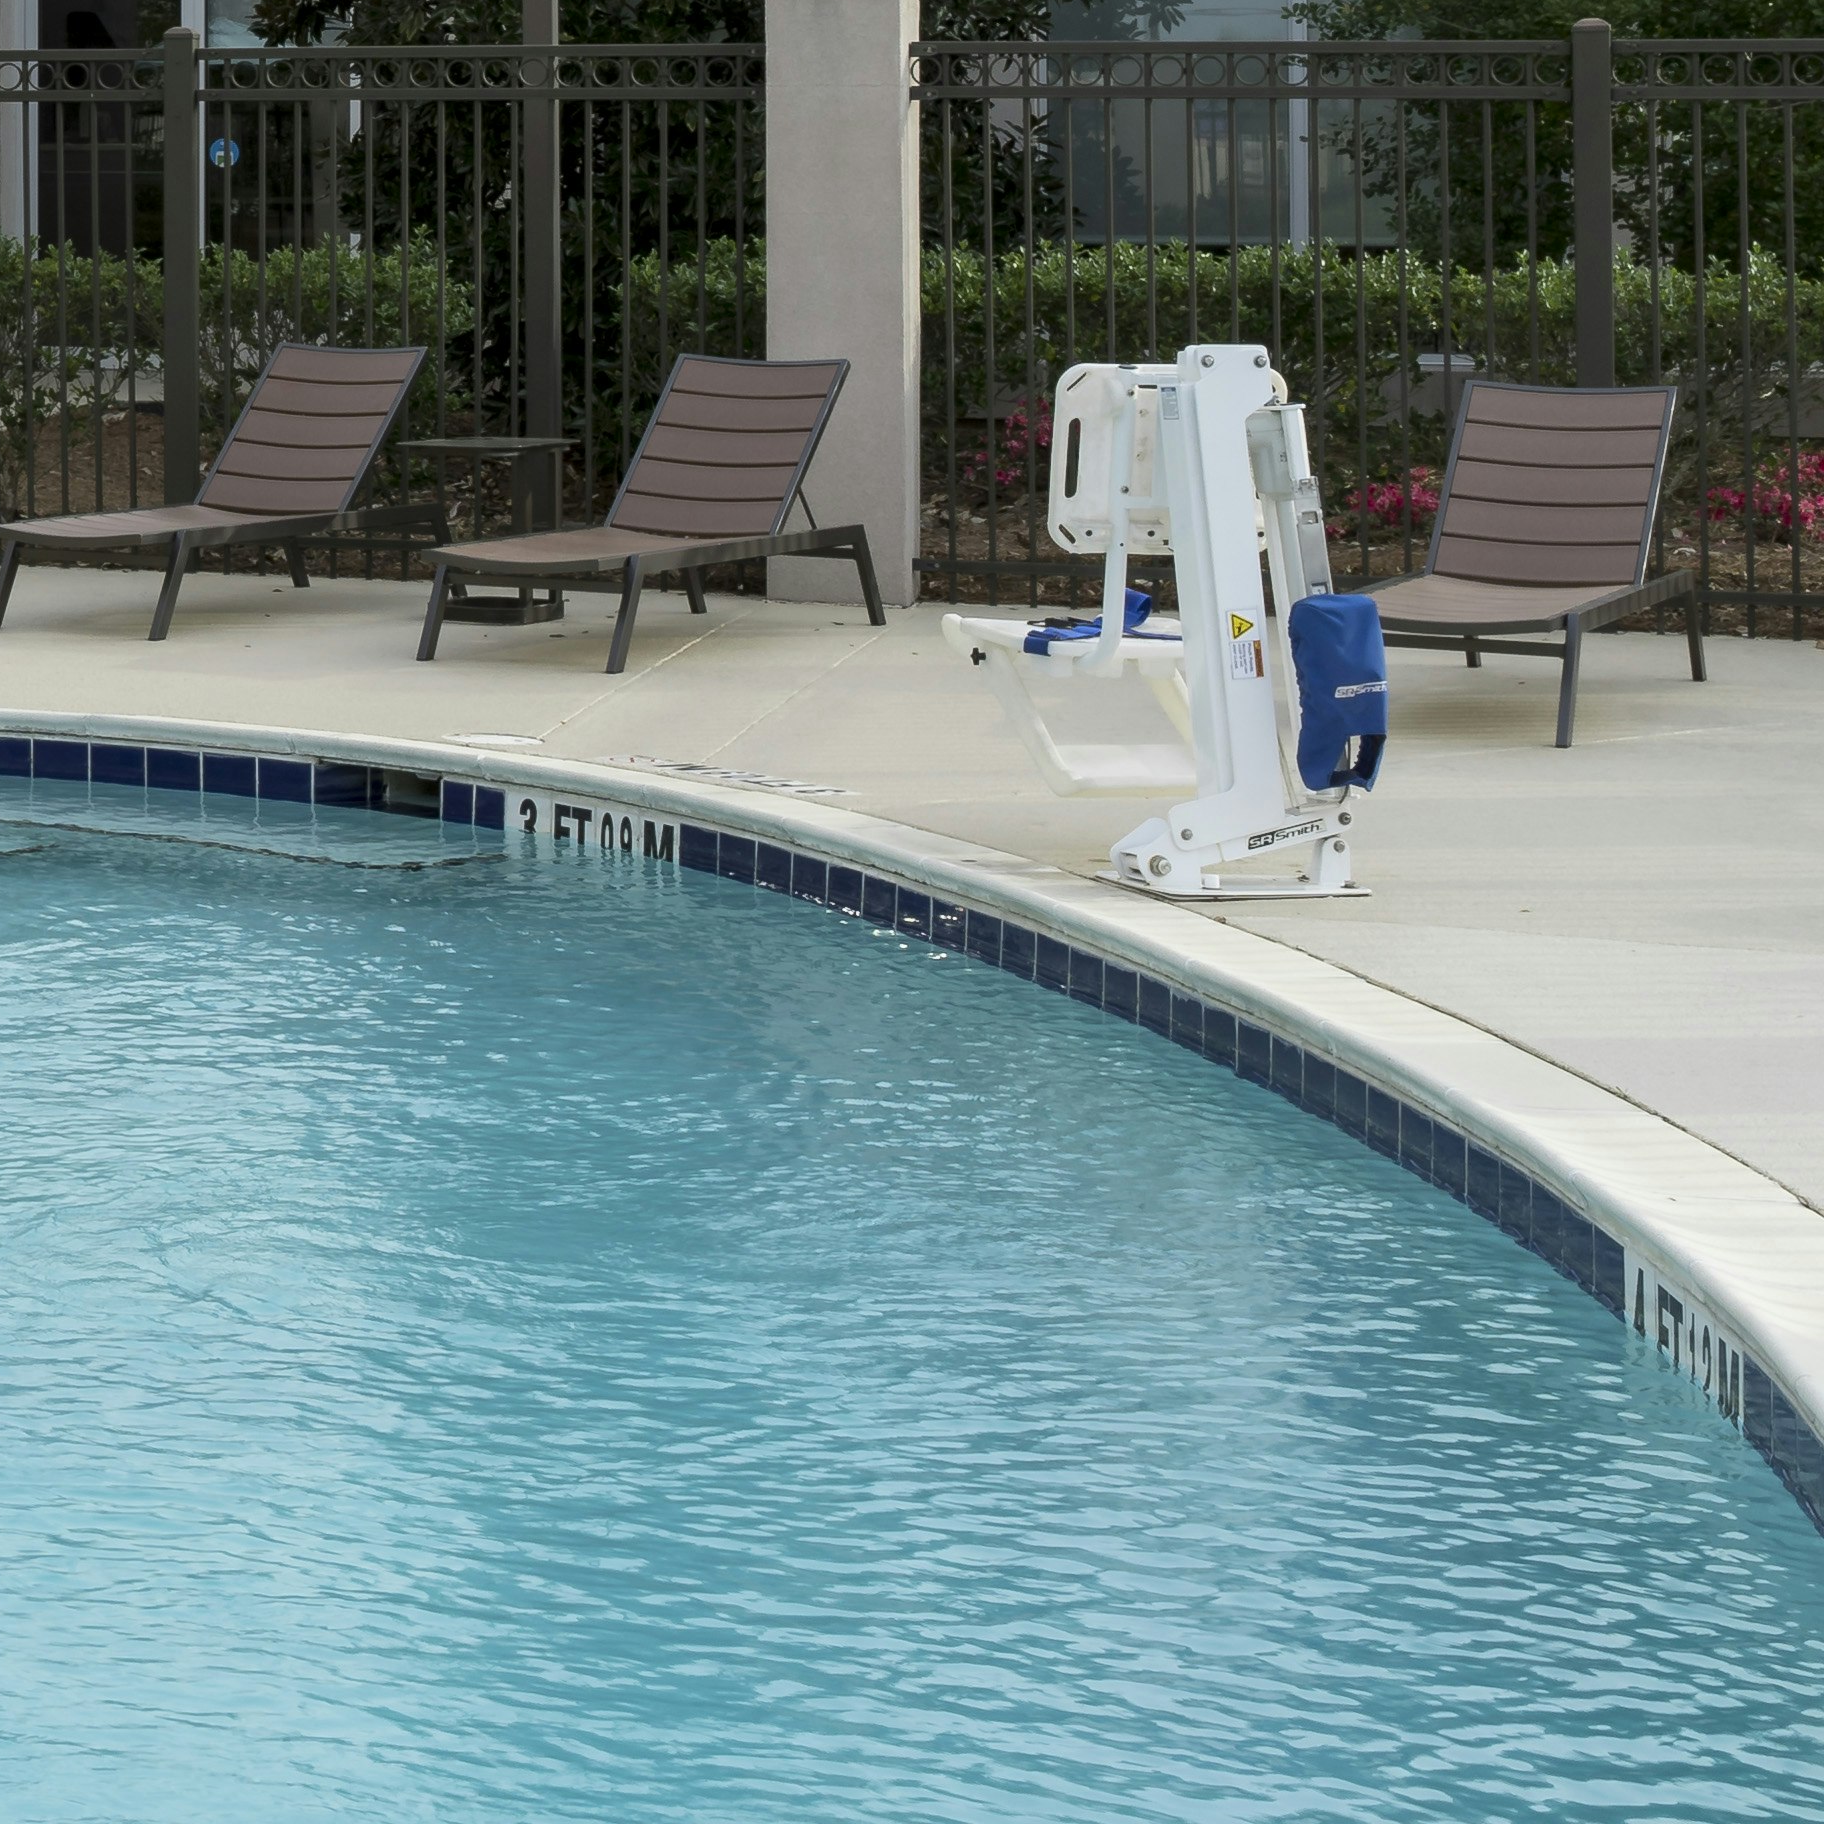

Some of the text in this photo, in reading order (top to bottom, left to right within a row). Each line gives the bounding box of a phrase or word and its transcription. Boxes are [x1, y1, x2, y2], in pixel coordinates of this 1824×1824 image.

[554, 803, 593, 845] FT
[643, 819, 675, 863] M
[1656, 1283, 1684, 1371] FT
[1717, 1336, 1740, 1430] M
